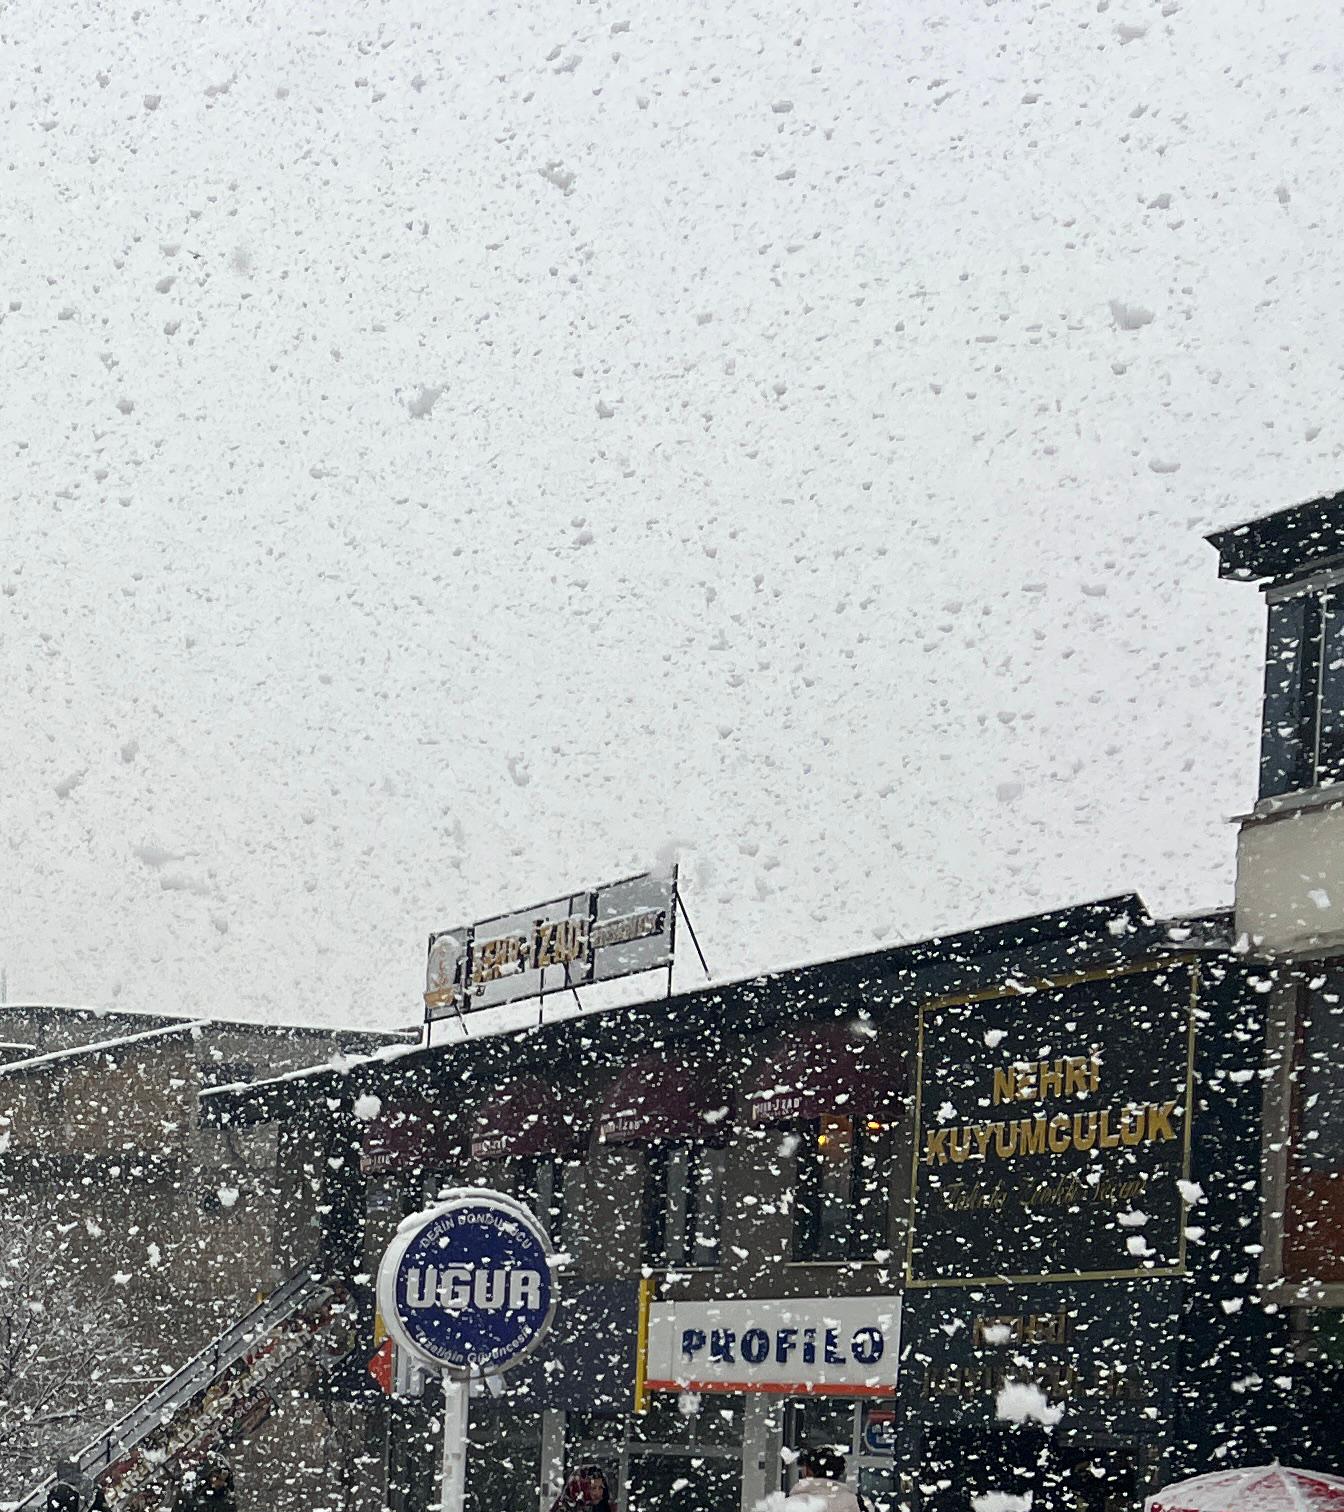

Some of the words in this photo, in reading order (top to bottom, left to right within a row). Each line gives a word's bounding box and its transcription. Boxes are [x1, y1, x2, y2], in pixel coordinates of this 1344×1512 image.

[926, 1100, 1178, 1166] KUYUMCULUK
[458, 1212, 532, 1249] DONDUUCU
[406, 1262, 541, 1310] UĞUR
[682, 1327, 885, 1364] PROFİLO
